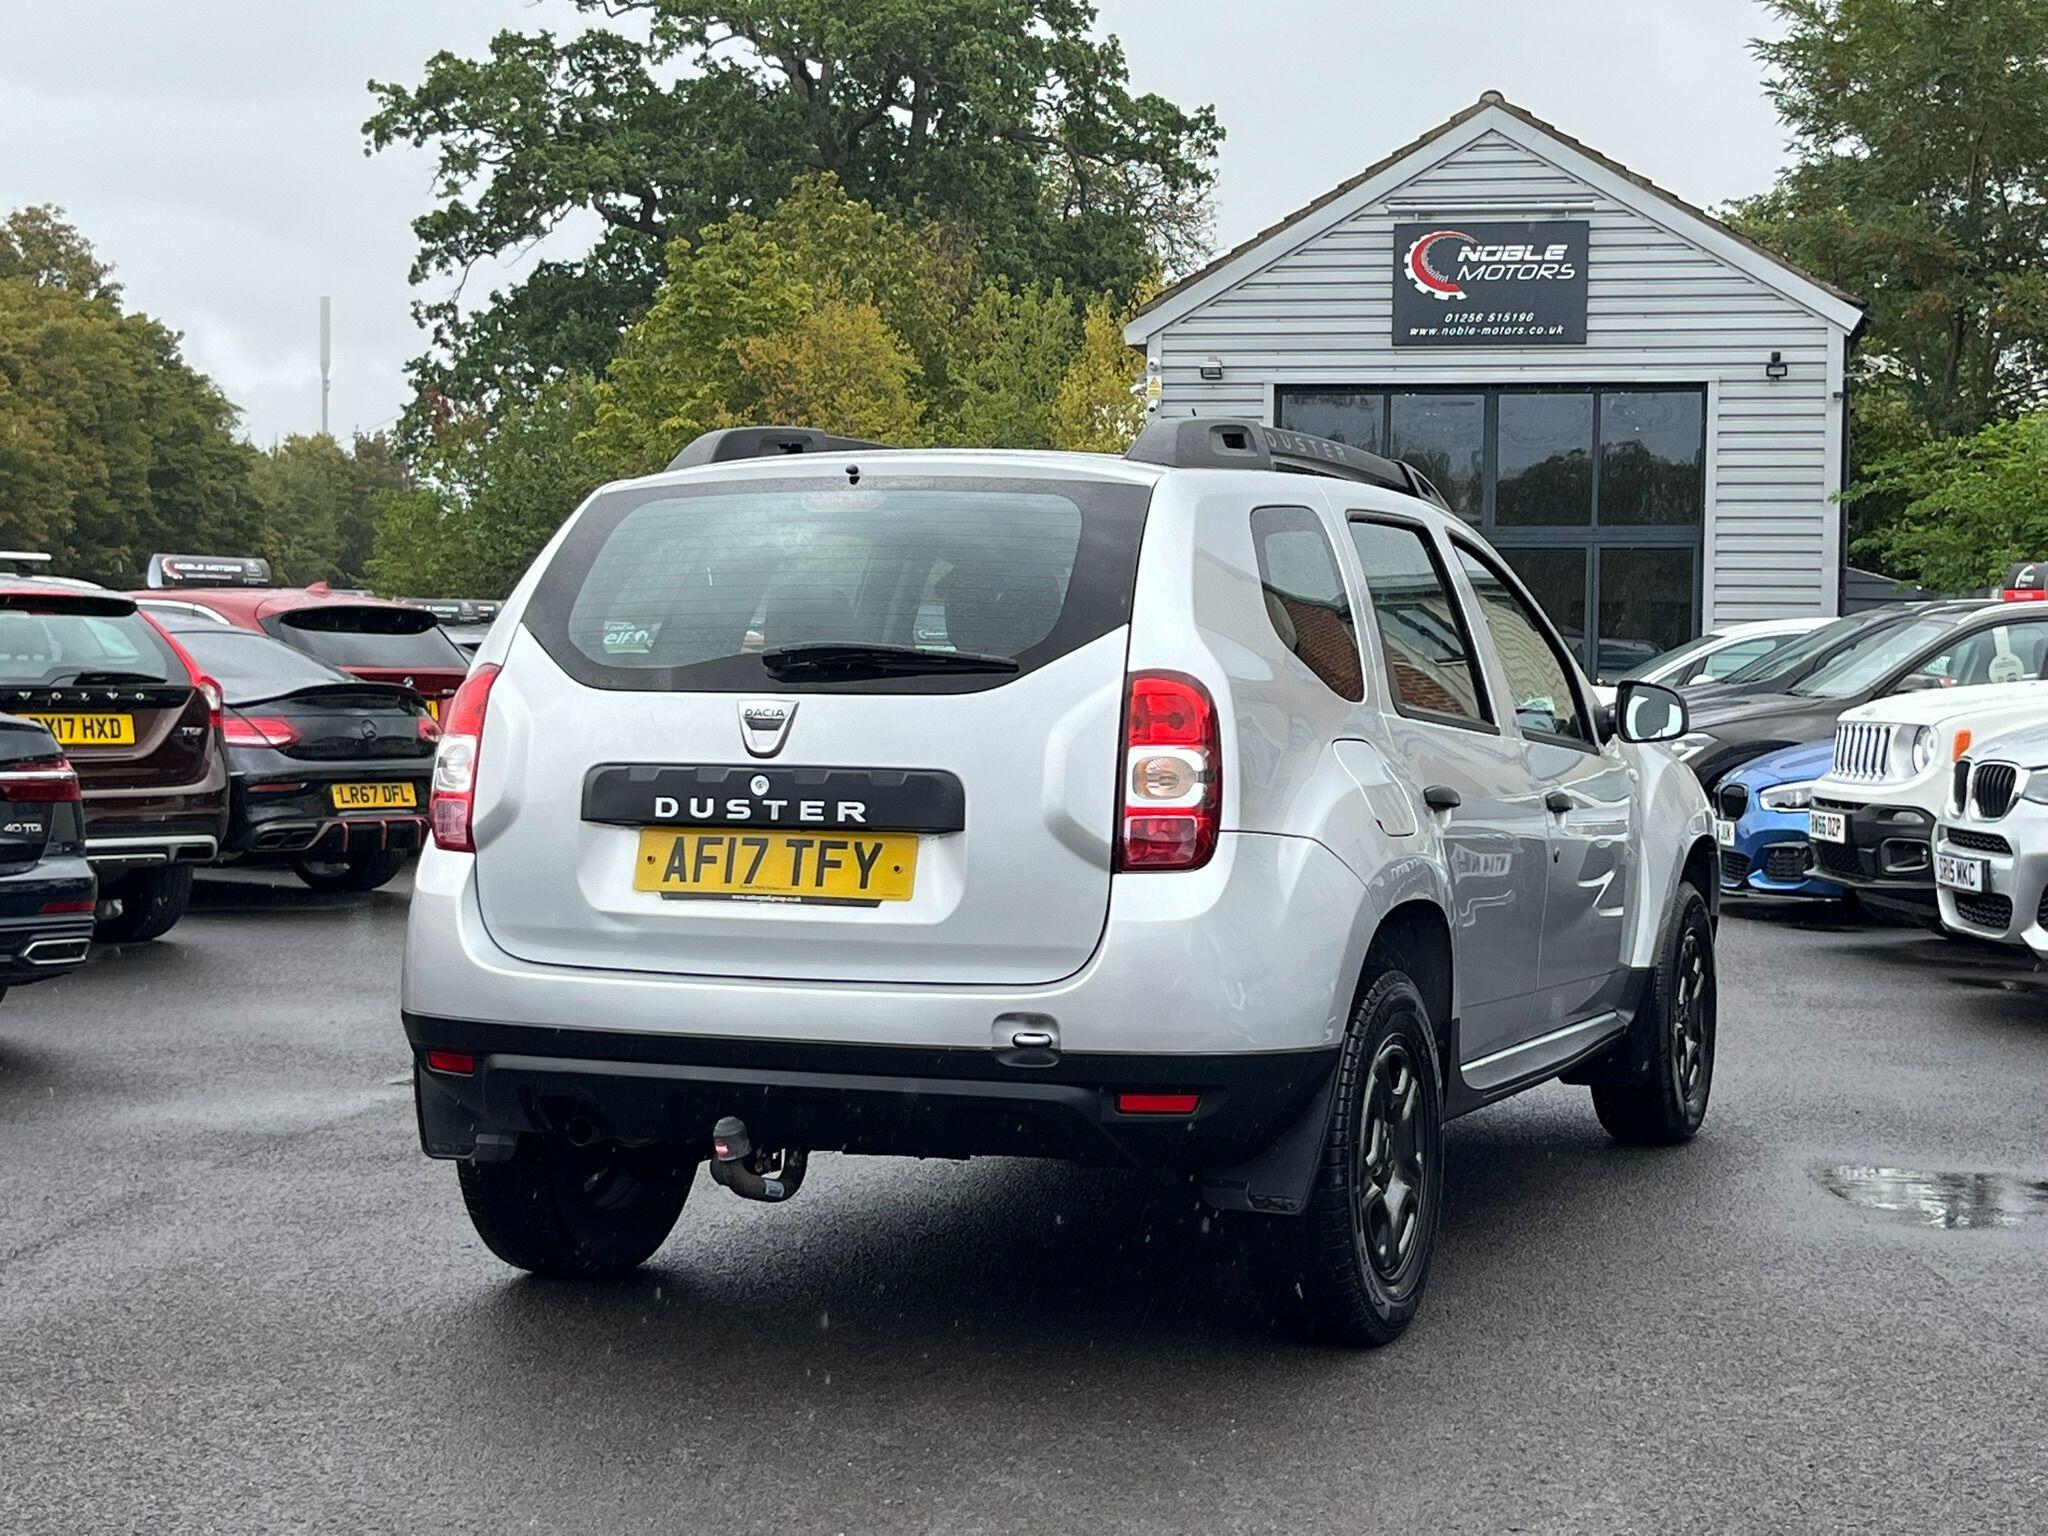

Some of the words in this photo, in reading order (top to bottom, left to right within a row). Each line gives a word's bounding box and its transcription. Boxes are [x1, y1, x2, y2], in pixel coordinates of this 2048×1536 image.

[1457, 244, 1569, 262] NOBLE
[1456, 263, 1576, 281] MOTORS
[1444, 313, 1484, 323] 01256
[1487, 312, 1534, 323] 515196
[1409, 325, 1565, 336] www.noble-motors.co.uk
[1264, 432, 1347, 461] DUSTER
[18, 691, 145, 701] VOLVO
[744, 708, 785, 717] DACIA
[82, 717, 121, 739] HXD
[340, 786, 377, 803] LR67
[382, 785, 410, 803] DFL
[655, 797, 866, 823] DUSTER
[3, 823, 22, 832] 40
[662, 836, 769, 884] AF17
[786, 839, 883, 889] TFY
